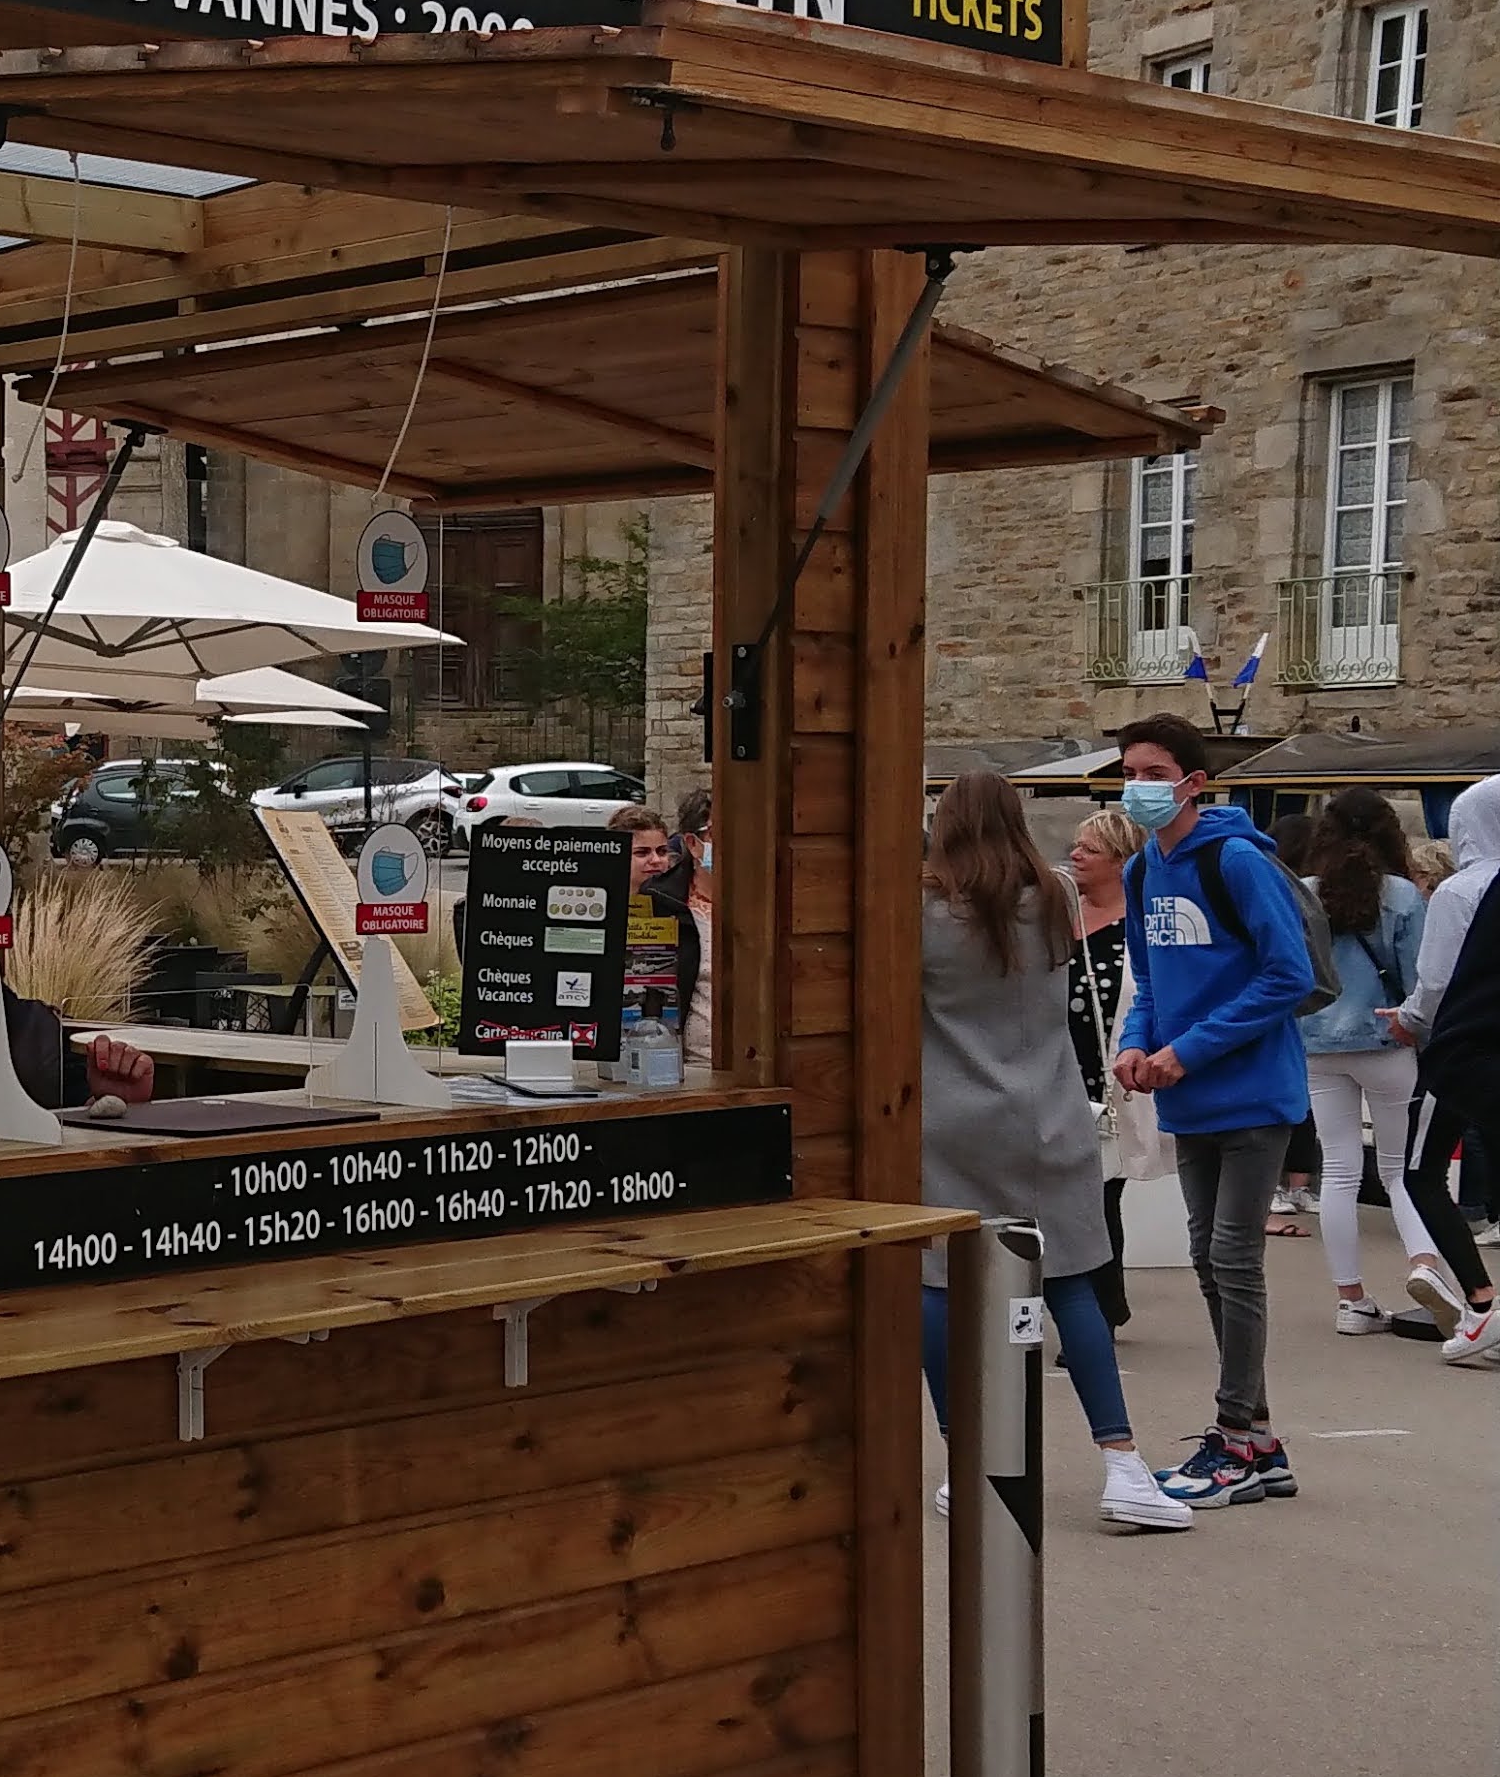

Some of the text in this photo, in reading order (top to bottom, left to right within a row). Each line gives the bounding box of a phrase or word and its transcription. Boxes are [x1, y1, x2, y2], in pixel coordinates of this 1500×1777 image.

[373, 594, 415, 606] MASQUE
[362, 607, 426, 619] OBLIGATOIRE
[481, 833, 622, 855] Moyens de paiements
[522, 857, 579, 876] acceptés
[482, 892, 537, 910] Monnaie
[1151, 896, 1174, 913] THE
[372, 905, 415, 917] MASQUE
[362, 918, 425, 931] OBLIGATOIRE
[1144, 913, 1175, 931] ORTH
[480, 930, 534, 950] Chèques
[1146, 929, 1177, 947] FACE
[478, 968, 532, 987] Chèques
[477, 987, 534, 1004] Vacances
[475, 1024, 508, 1040] Carte
[230, 1160, 308, 1198] 10h00
[329, 1149, 402, 1186] 10h40
[422, 1140, 493, 1177] 11h20
[512, 1132, 581, 1168] 12h00
[33, 1231, 117, 1271] 14h00
[141, 1220, 222, 1259] 14h40
[244, 1209, 321, 1248] 15h20
[342, 1198, 416, 1235] 16h00
[435, 1188, 506, 1224] 16h40
[525, 1179, 592, 1215] 17h20
[610, 1170, 675, 1205] 18h00
